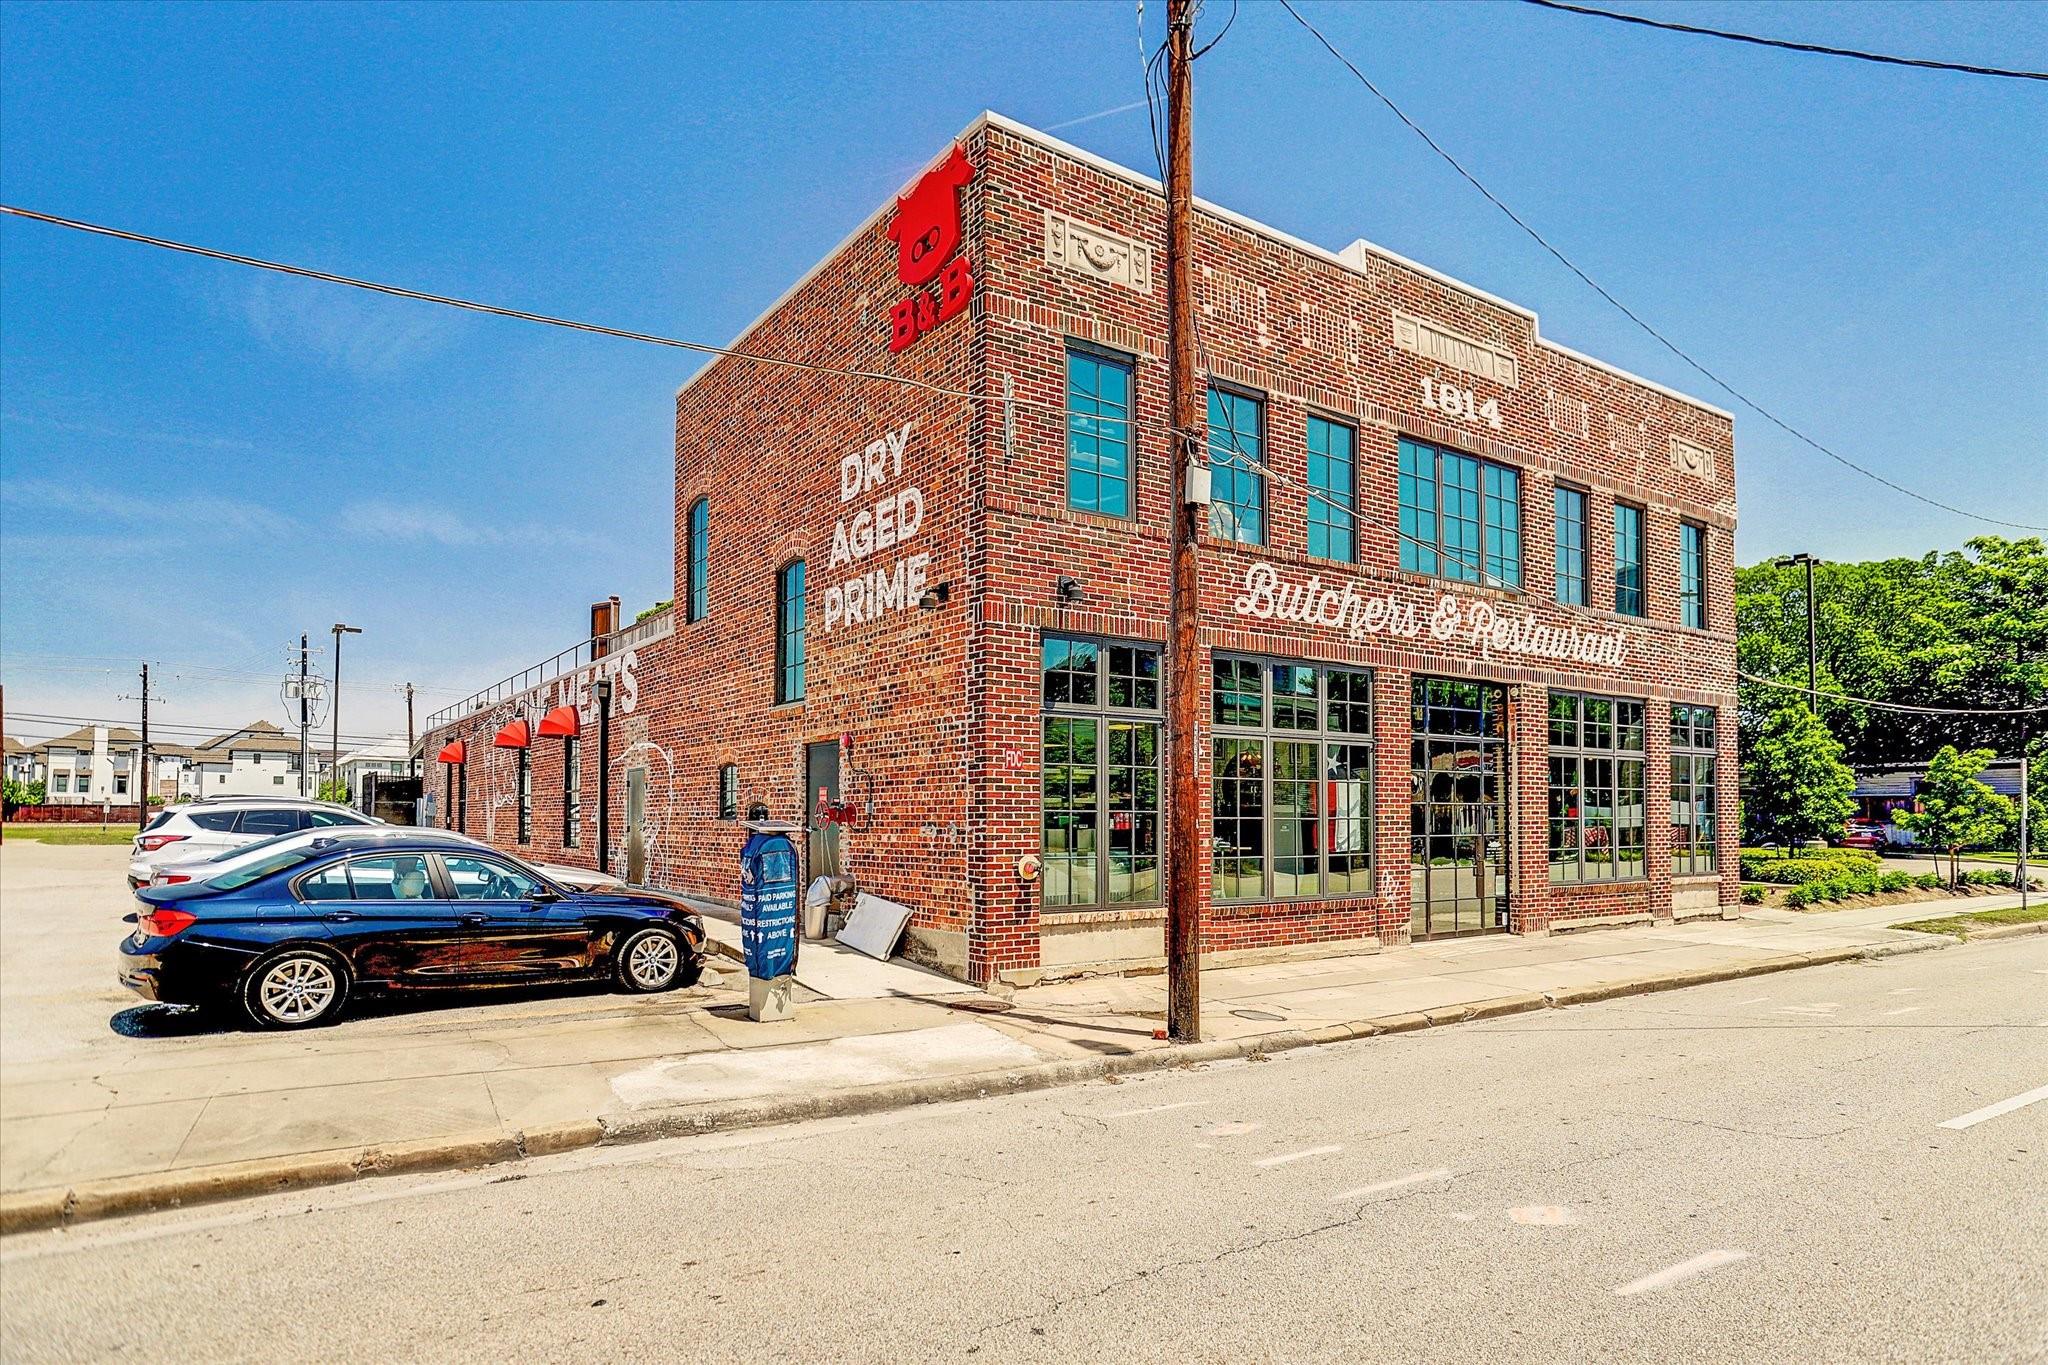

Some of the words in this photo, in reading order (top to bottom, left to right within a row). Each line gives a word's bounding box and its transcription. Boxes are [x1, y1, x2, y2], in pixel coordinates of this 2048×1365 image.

[889, 255, 974, 353] B&B
[1420, 375, 1504, 428] 1814
[841, 423, 911, 502] DRY
[828, 487, 924, 570] AGED
[824, 552, 930, 633] PRIME
[1235, 563, 1422, 637] Butchers
[1431, 595, 1461, 640] &
[1469, 600, 1628, 666] Restaurant
[1006, 750, 1022, 768] FDC
[762, 901, 793, 912] AVAILABLE
[767, 929, 788, 939] ABOVE
